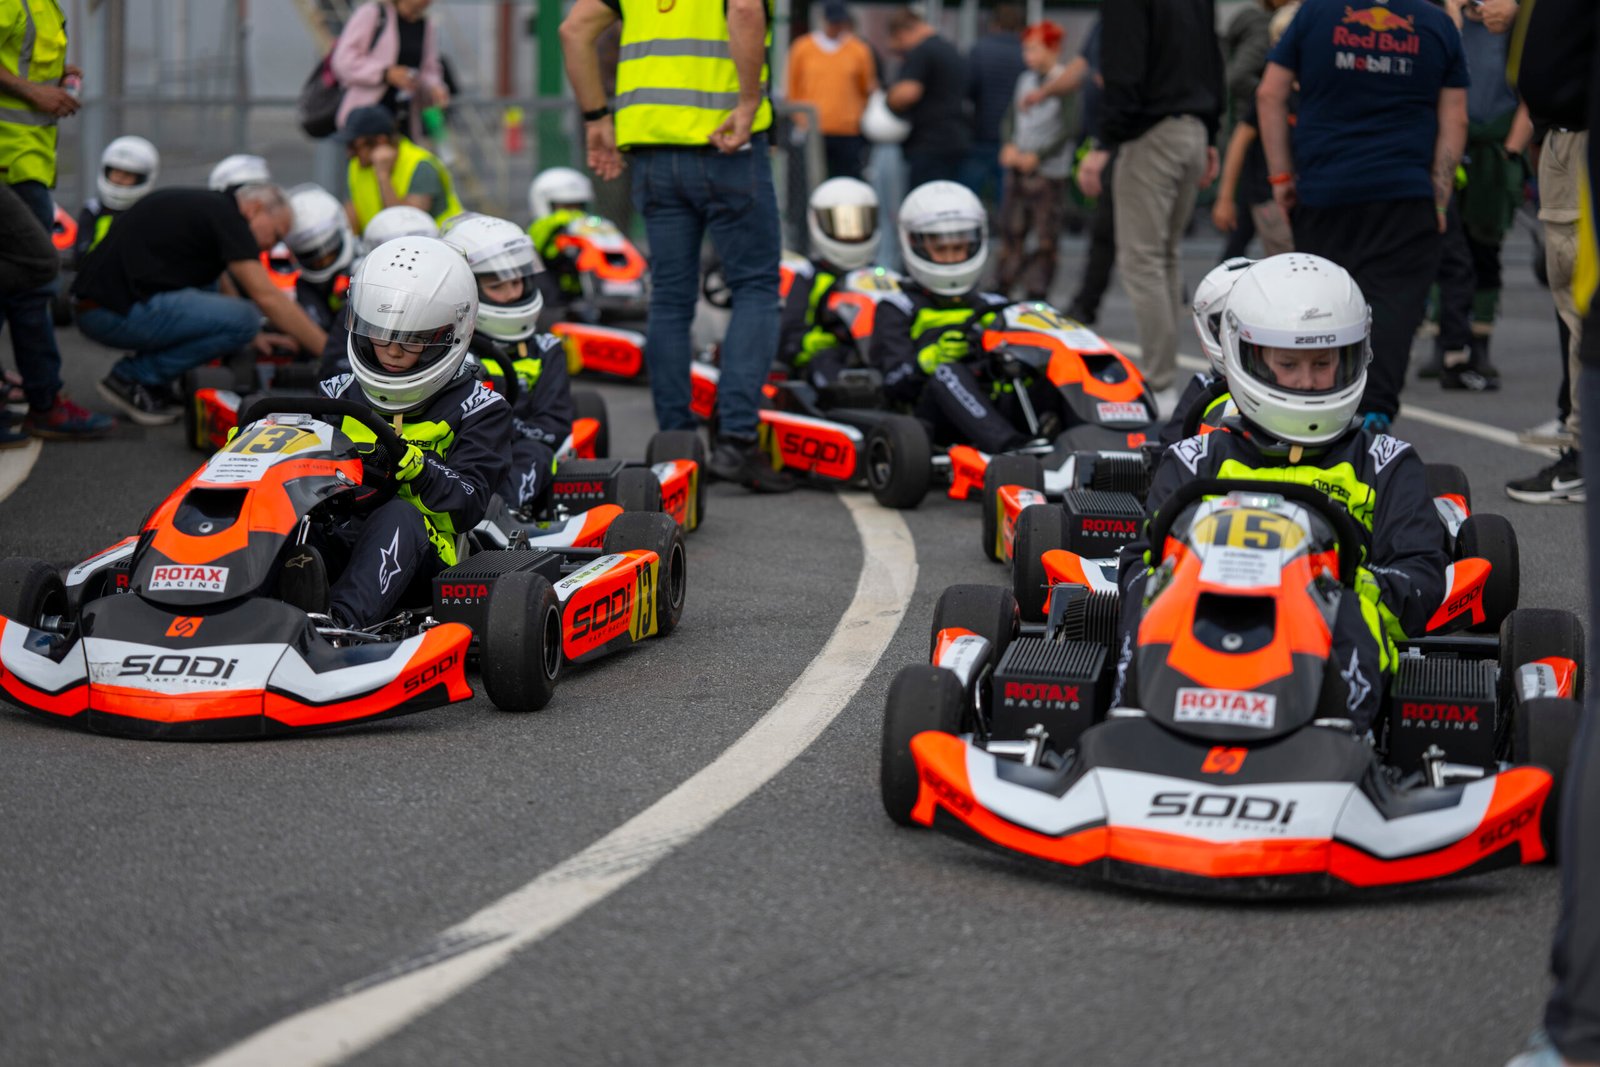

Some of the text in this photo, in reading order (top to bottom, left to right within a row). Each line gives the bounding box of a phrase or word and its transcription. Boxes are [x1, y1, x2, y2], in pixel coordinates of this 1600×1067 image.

[1333, 26, 1420, 55] Red Bull
[1336, 51, 1391, 74] Mobil
[230, 426, 300, 453] 13
[552, 481, 604, 494] ROTAX
[1082, 519, 1137, 532] ROTAX
[1213, 514, 1282, 550] 15
[1081, 530, 1137, 539] RACING
[153, 567, 223, 582] ROTAX
[152, 581, 220, 589] RACING
[441, 584, 489, 598] ROTA
[635, 560, 653, 640] 13
[1004, 682, 1080, 702] ROTAX
[1004, 698, 1081, 710] RACING
[1182, 693, 1266, 714] ROTAX
[1402, 703, 1479, 722] ROTAX
[1401, 718, 1479, 731] RACING
